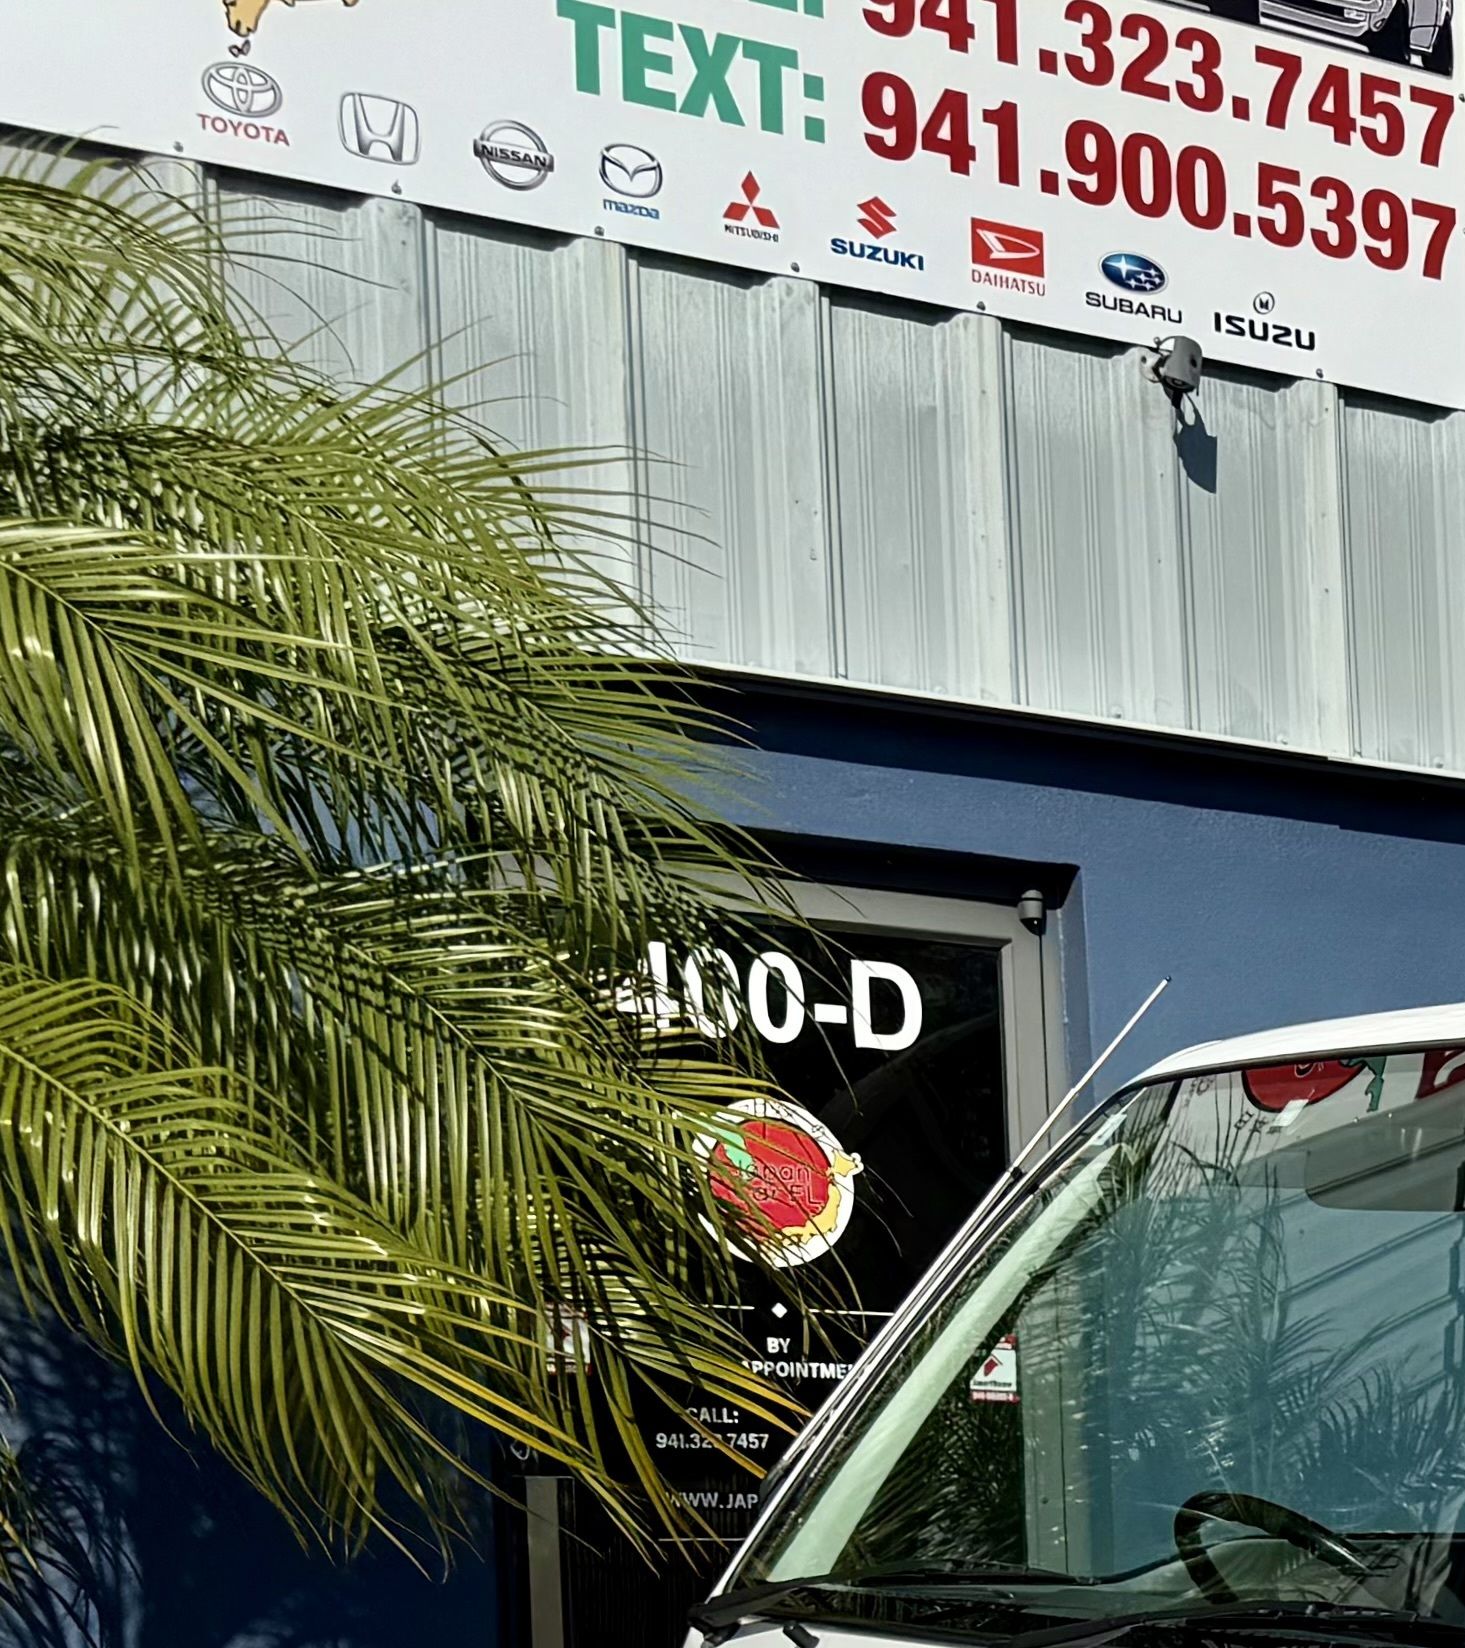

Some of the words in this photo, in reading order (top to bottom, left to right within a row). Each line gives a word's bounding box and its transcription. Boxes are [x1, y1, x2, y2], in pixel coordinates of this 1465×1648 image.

[197, 113, 290, 147] TOYOTA
[555, 0, 826, 144] TEXT:
[860, 71, 1457, 281] 941.900.5397
[480, 143, 548, 170] NISSAN
[602, 199, 660, 220] mazda
[723, 223, 780, 244] MITSUBISHI
[830, 237, 924, 272] SUZUKI
[971, 269, 1046, 297] DAIHATSU
[1085, 291, 1183, 324] SUBARU
[1213, 312, 1316, 351] ISUZU
[766, 1337, 791, 1354] BY
[741, 1360, 854, 1380] PPOINTME
[685, 1407, 739, 1424] CALL:
[655, 1433, 769, 1450] 941.327457
